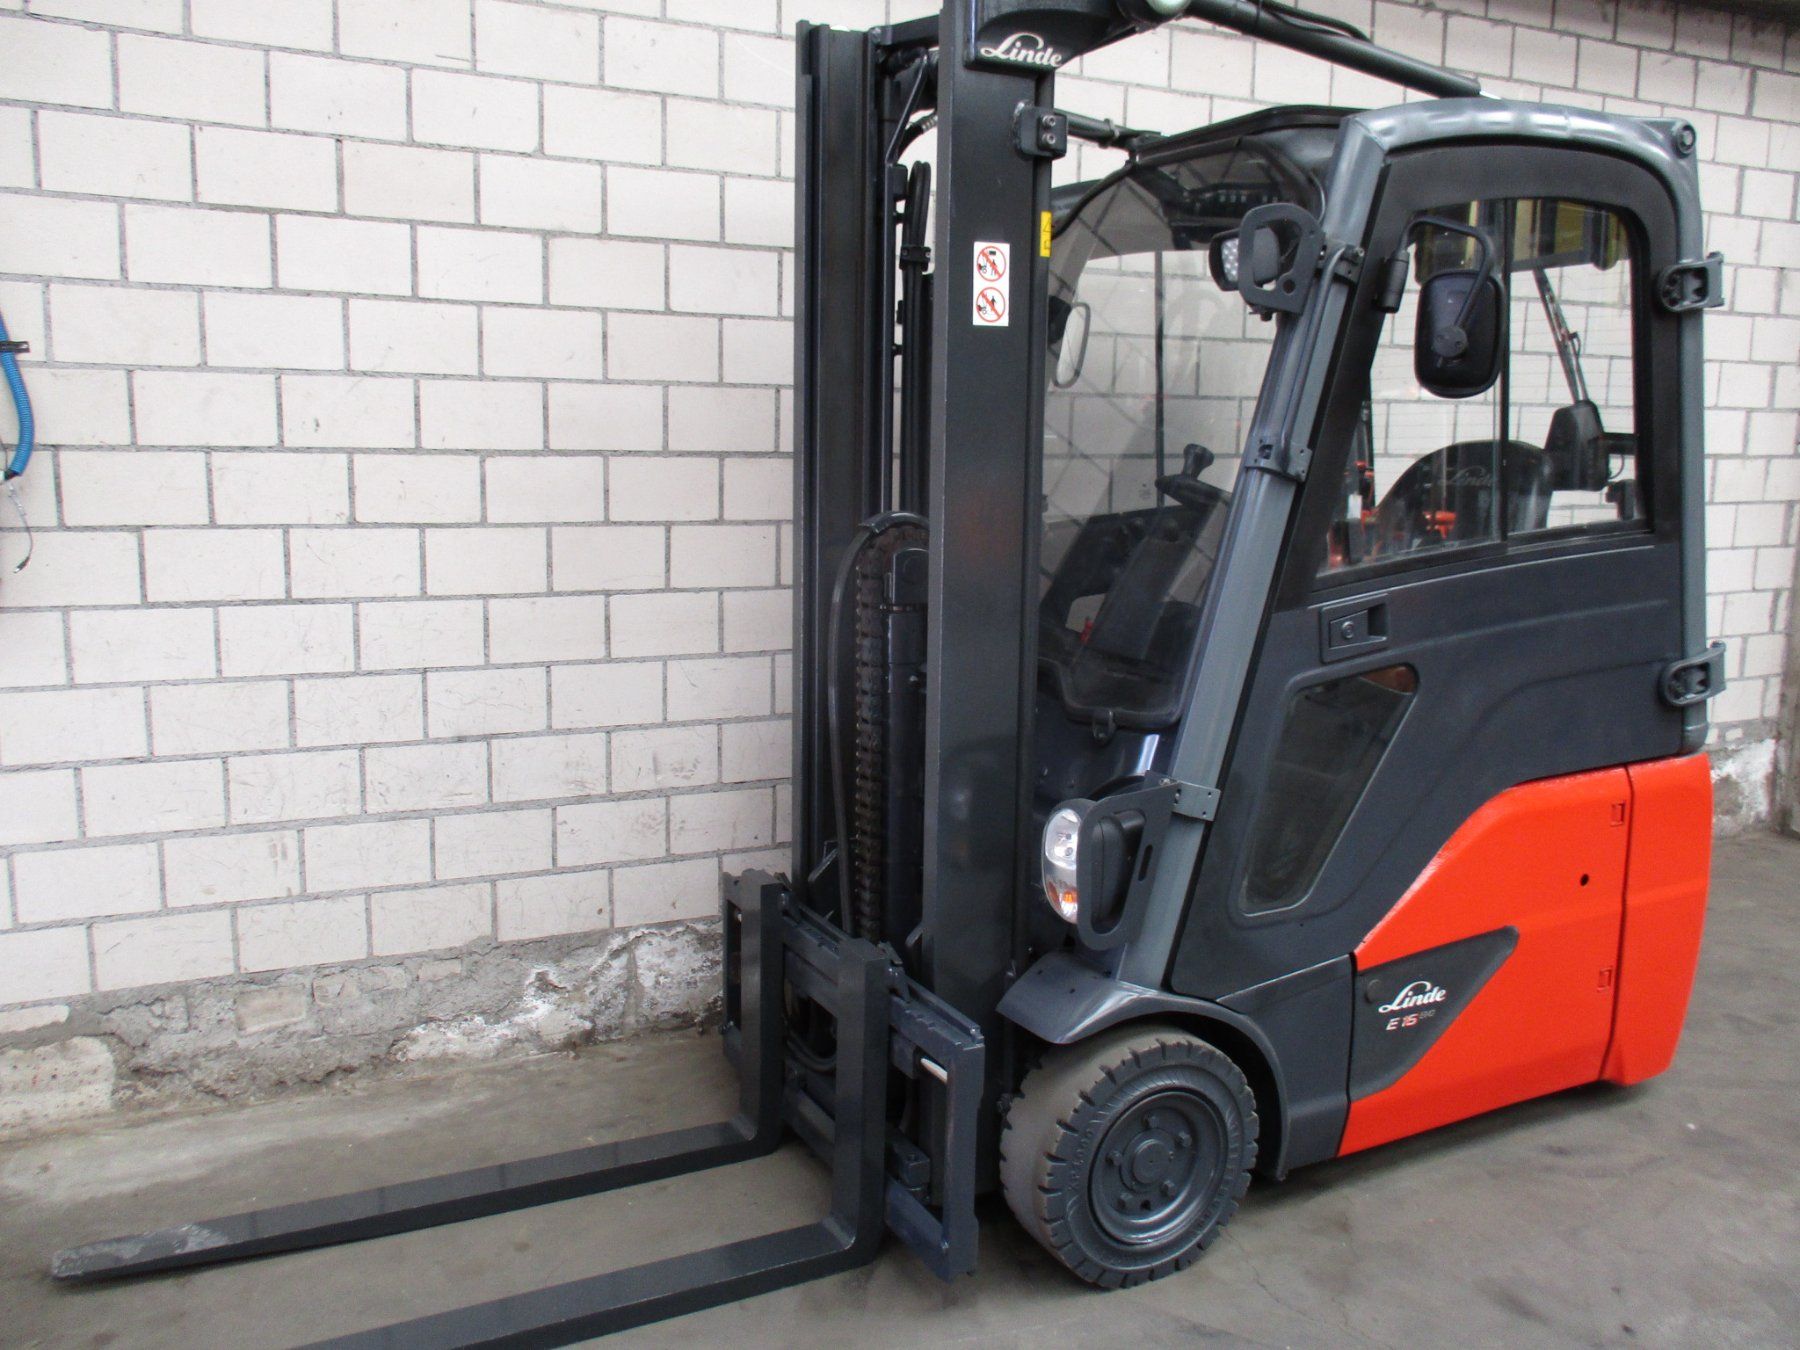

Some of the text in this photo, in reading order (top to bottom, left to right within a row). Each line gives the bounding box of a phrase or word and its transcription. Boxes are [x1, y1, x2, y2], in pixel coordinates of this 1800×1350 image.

[980, 32, 1062, 67] Linde
[1378, 980, 1447, 1013] Linde
[1385, 1017, 1400, 1031] E
